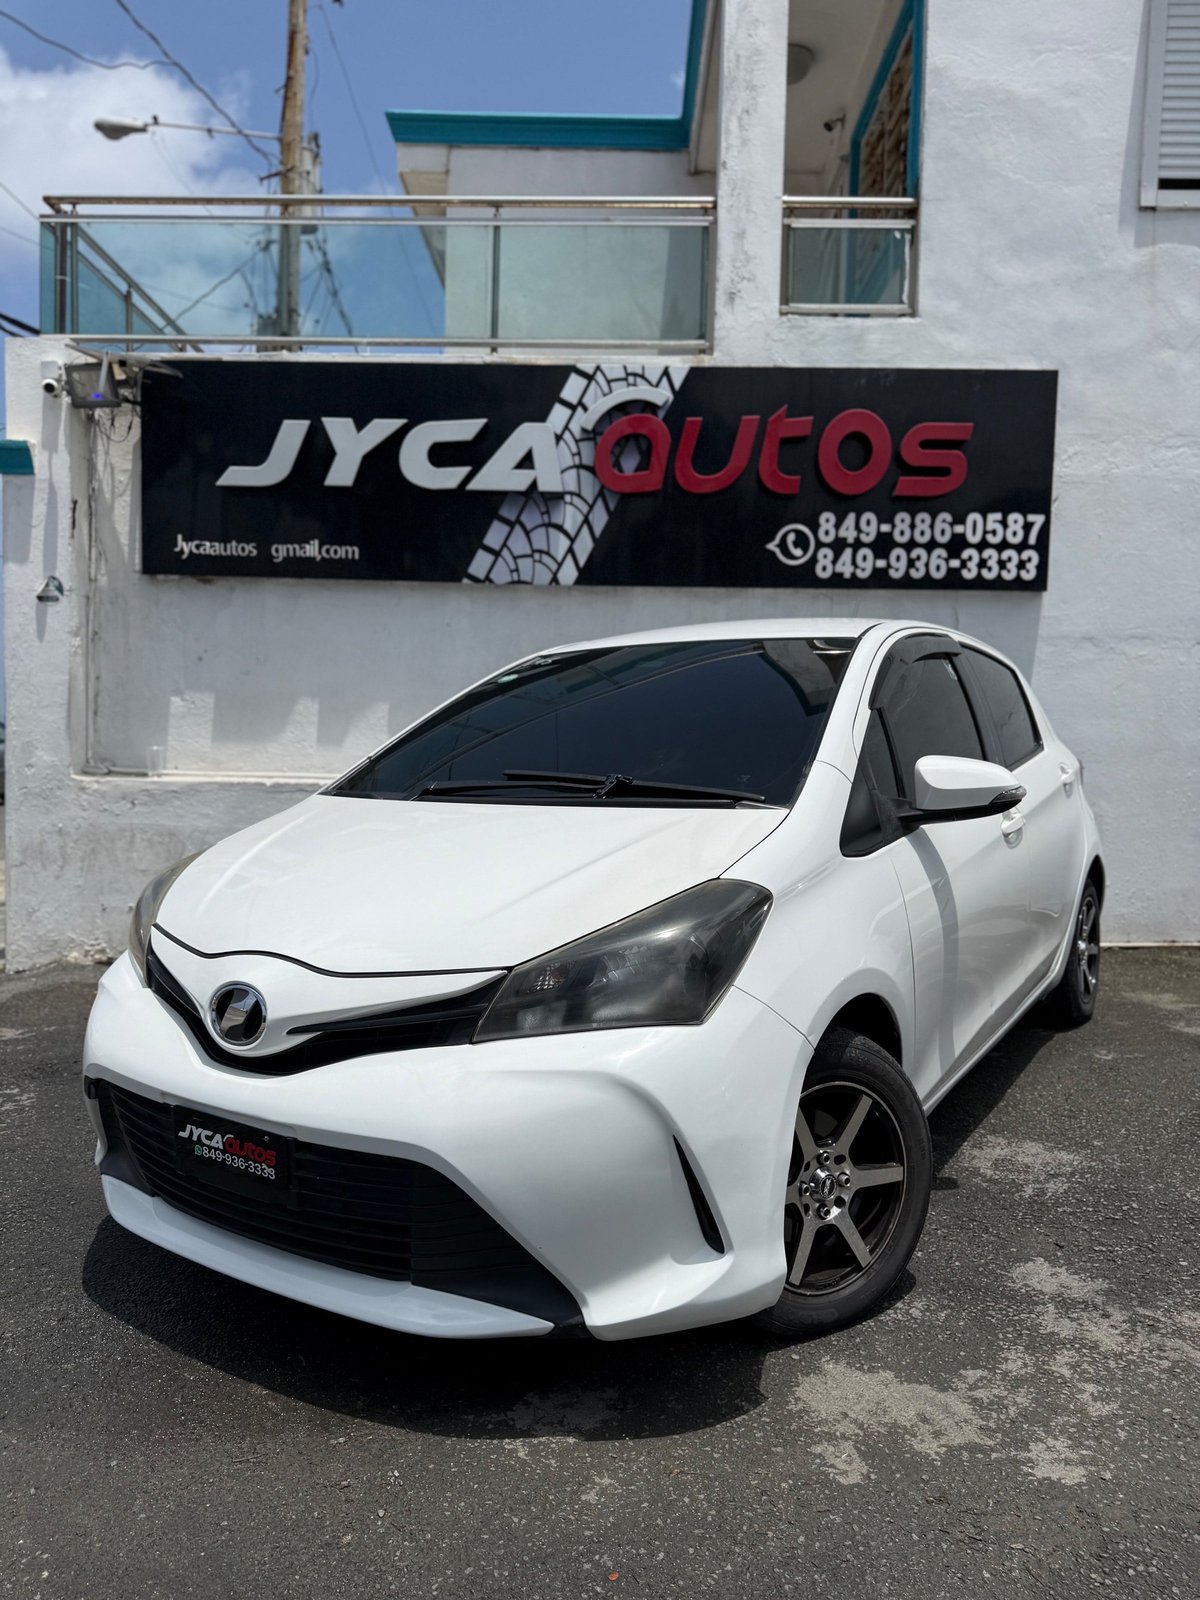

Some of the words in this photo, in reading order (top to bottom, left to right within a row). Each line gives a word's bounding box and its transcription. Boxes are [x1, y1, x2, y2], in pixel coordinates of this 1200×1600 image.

[215, 417, 562, 493] JYCA
[818, 511, 1045, 546] 849-886-0587
[174, 534, 257, 560] Jycaautos
[815, 547, 1039, 581] 849-936-3333
[178, 1124, 224, 1150] JYCA
